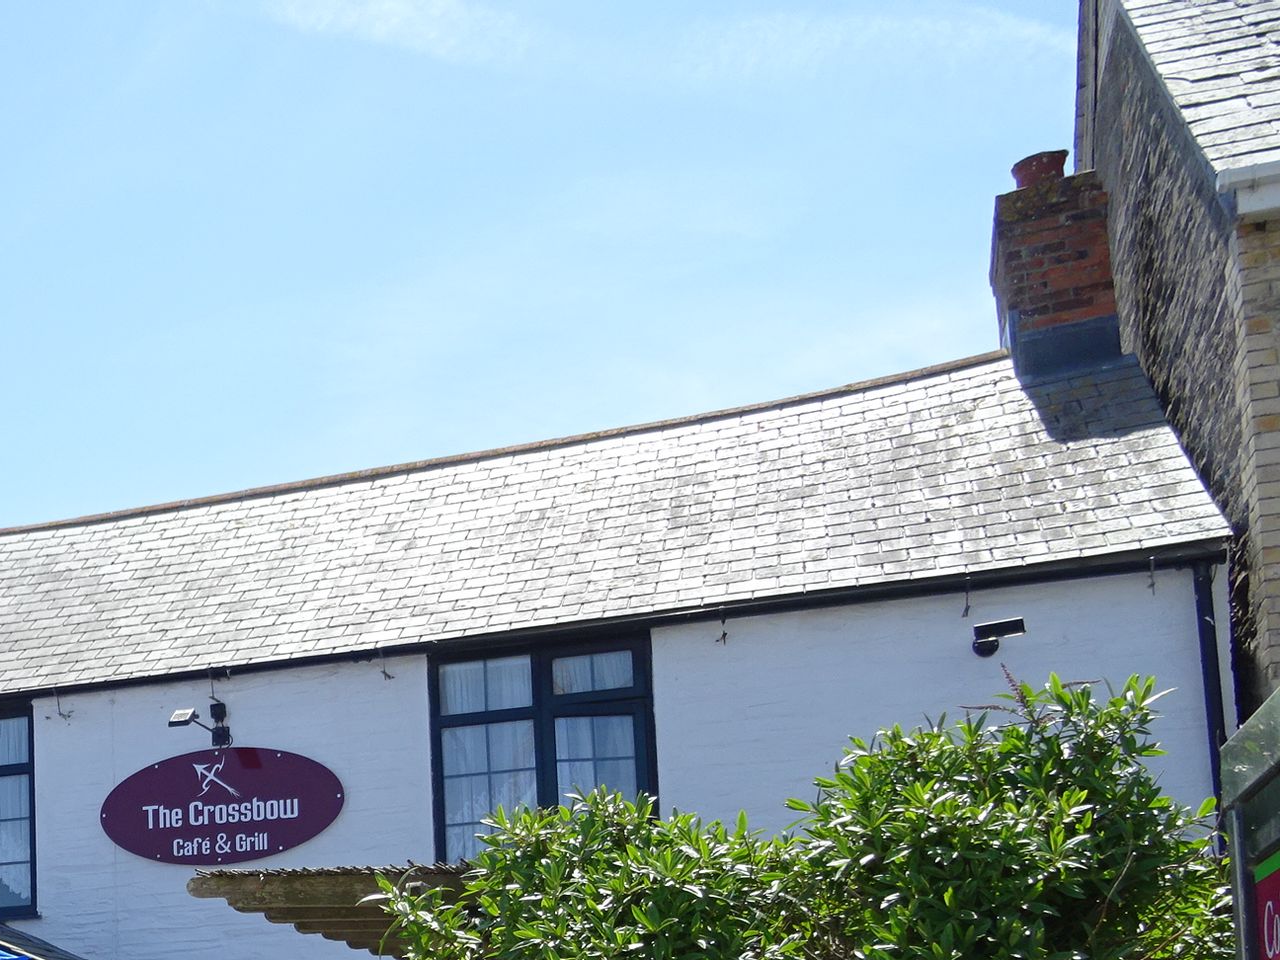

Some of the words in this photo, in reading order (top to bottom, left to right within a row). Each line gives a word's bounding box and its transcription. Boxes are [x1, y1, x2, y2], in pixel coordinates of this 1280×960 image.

[142, 804, 183, 830] The
[188, 796, 299, 827] Crossbow
[172, 837, 211, 857] Café
[215, 833, 231, 854] &
[235, 832, 268, 852] Grill
